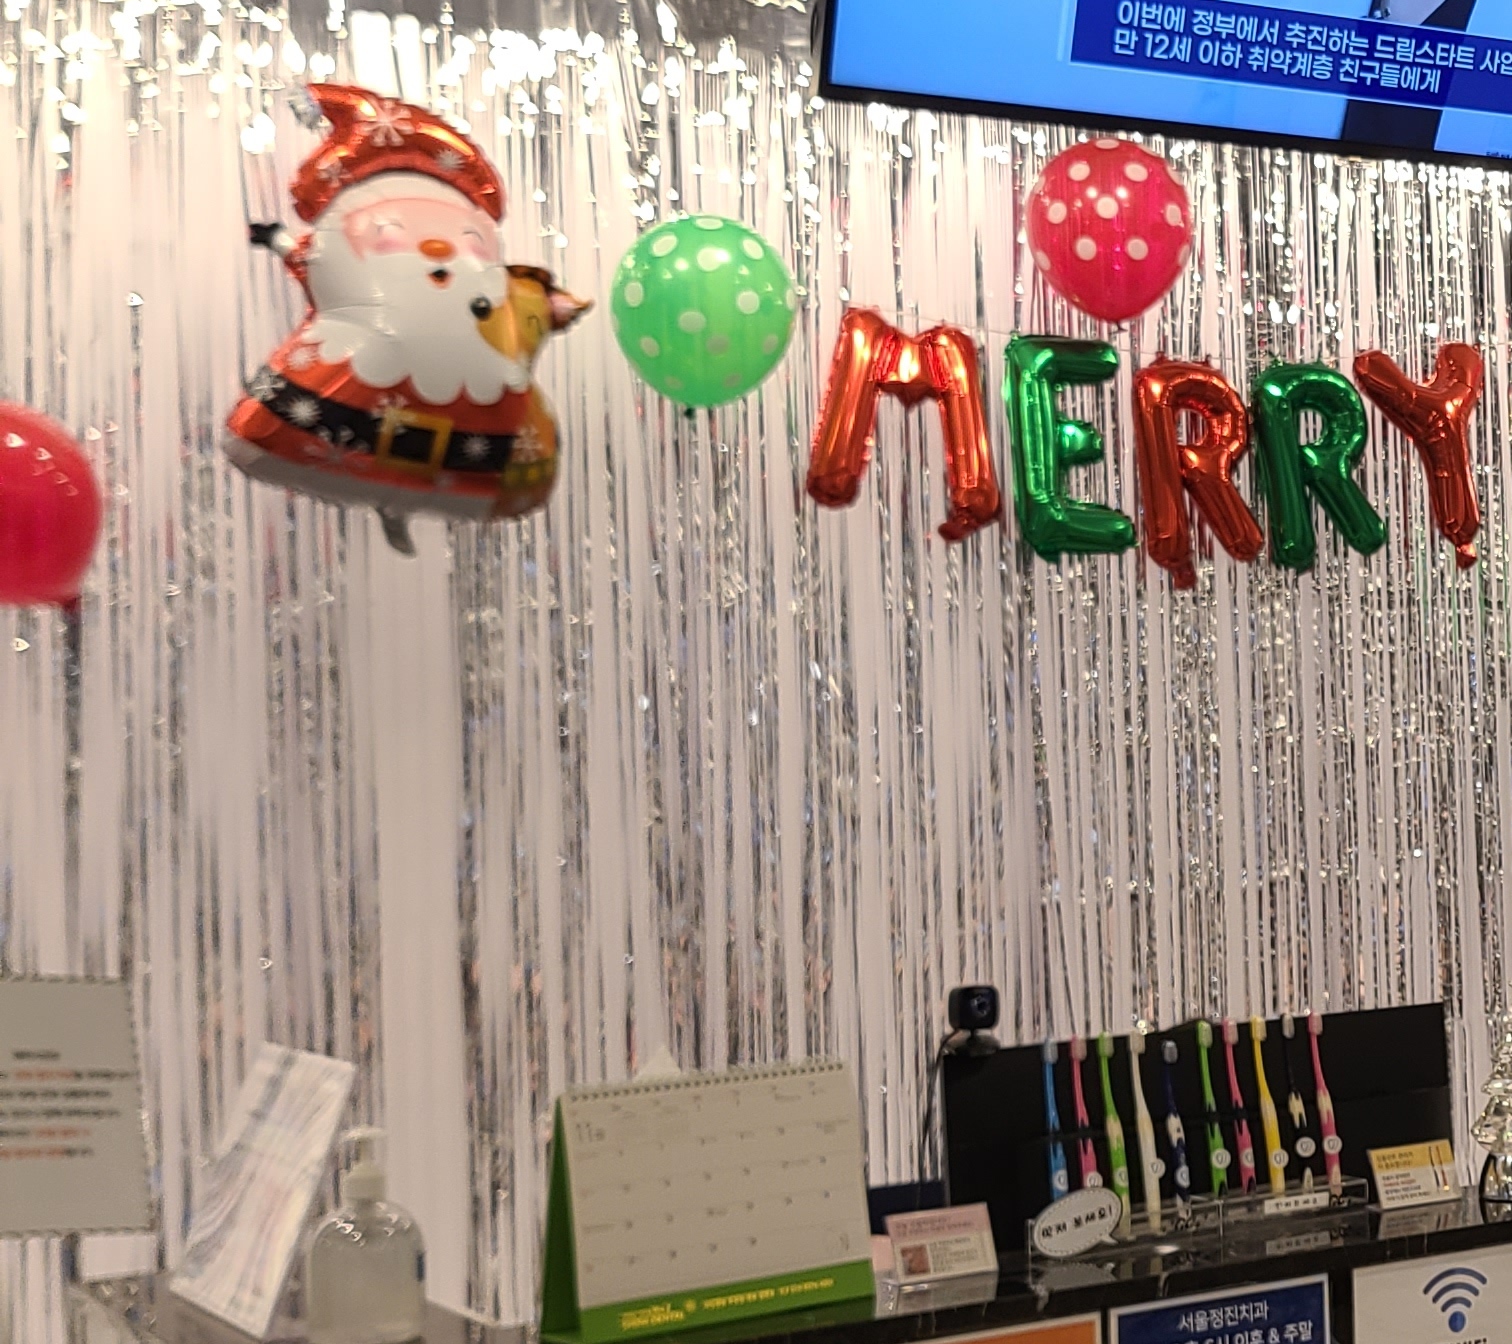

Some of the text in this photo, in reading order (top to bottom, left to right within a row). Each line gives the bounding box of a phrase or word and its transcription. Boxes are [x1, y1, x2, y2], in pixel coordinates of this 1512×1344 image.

[1113, 27, 1440, 95] 만 12세 이하 취약계층 친구들에게
[1191, 8, 1281, 47] 정부에서
[1285, 21, 1370, 59] 추진하는
[1373, 33, 1477, 72] 드림스타트
[807, 306, 1484, 590] MERRY
[1177, 1300, 1269, 1333] 서울정진치과
[1267, 1328, 1280, 1344] &
[1283, 1320, 1313, 1343] 주말
